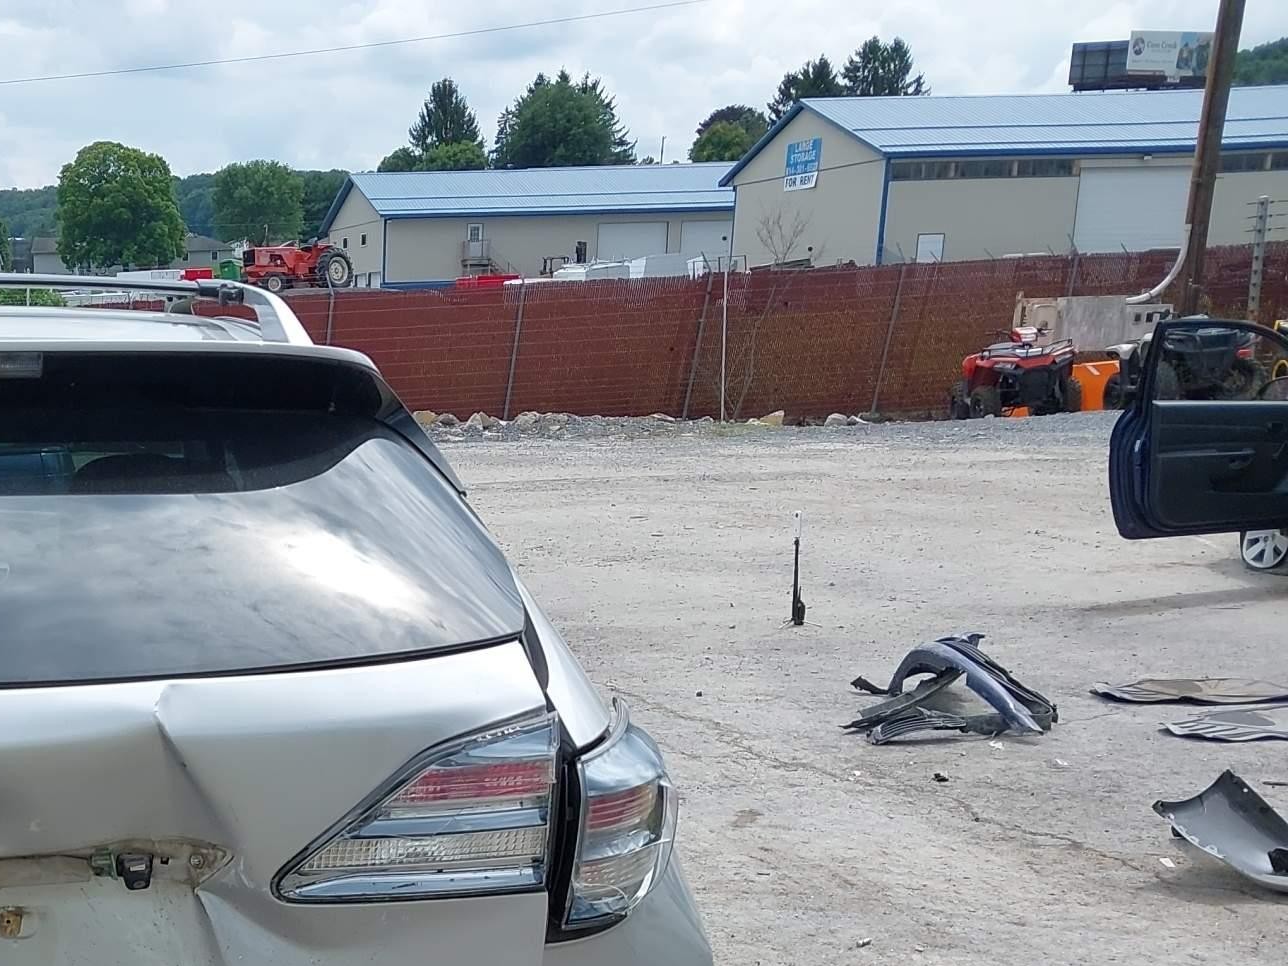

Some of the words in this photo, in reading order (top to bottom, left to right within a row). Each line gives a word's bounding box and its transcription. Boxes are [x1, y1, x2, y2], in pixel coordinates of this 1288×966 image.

[791, 151, 816, 163] STORAGE
[785, 177, 797, 188] FOR
[800, 175, 814, 185] RENT
